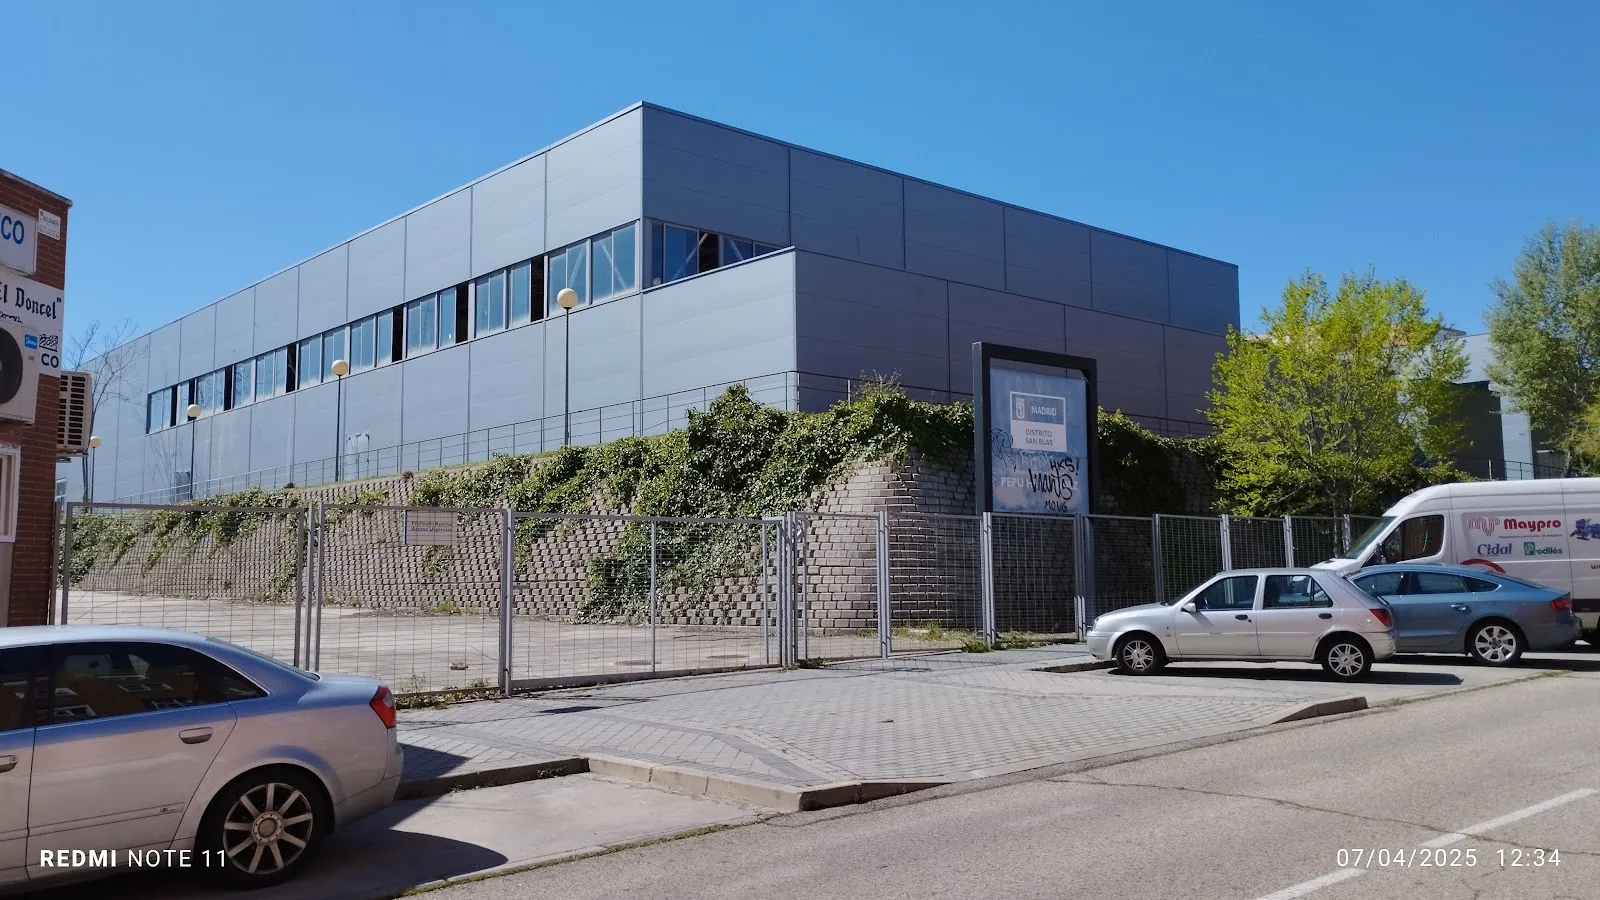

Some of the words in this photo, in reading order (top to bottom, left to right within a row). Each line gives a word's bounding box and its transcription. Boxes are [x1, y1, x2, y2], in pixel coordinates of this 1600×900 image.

[0, 214, 24, 244] CO
[1031, 405, 1057, 416] MADRID
[1025, 428, 1053, 437] DISTRITO
[1025, 437, 1038, 445] SAN
[1001, 476, 1024, 488] PEPU
[1503, 518, 1562, 533] Maypro
[1477, 543, 1513, 555] Cidal
